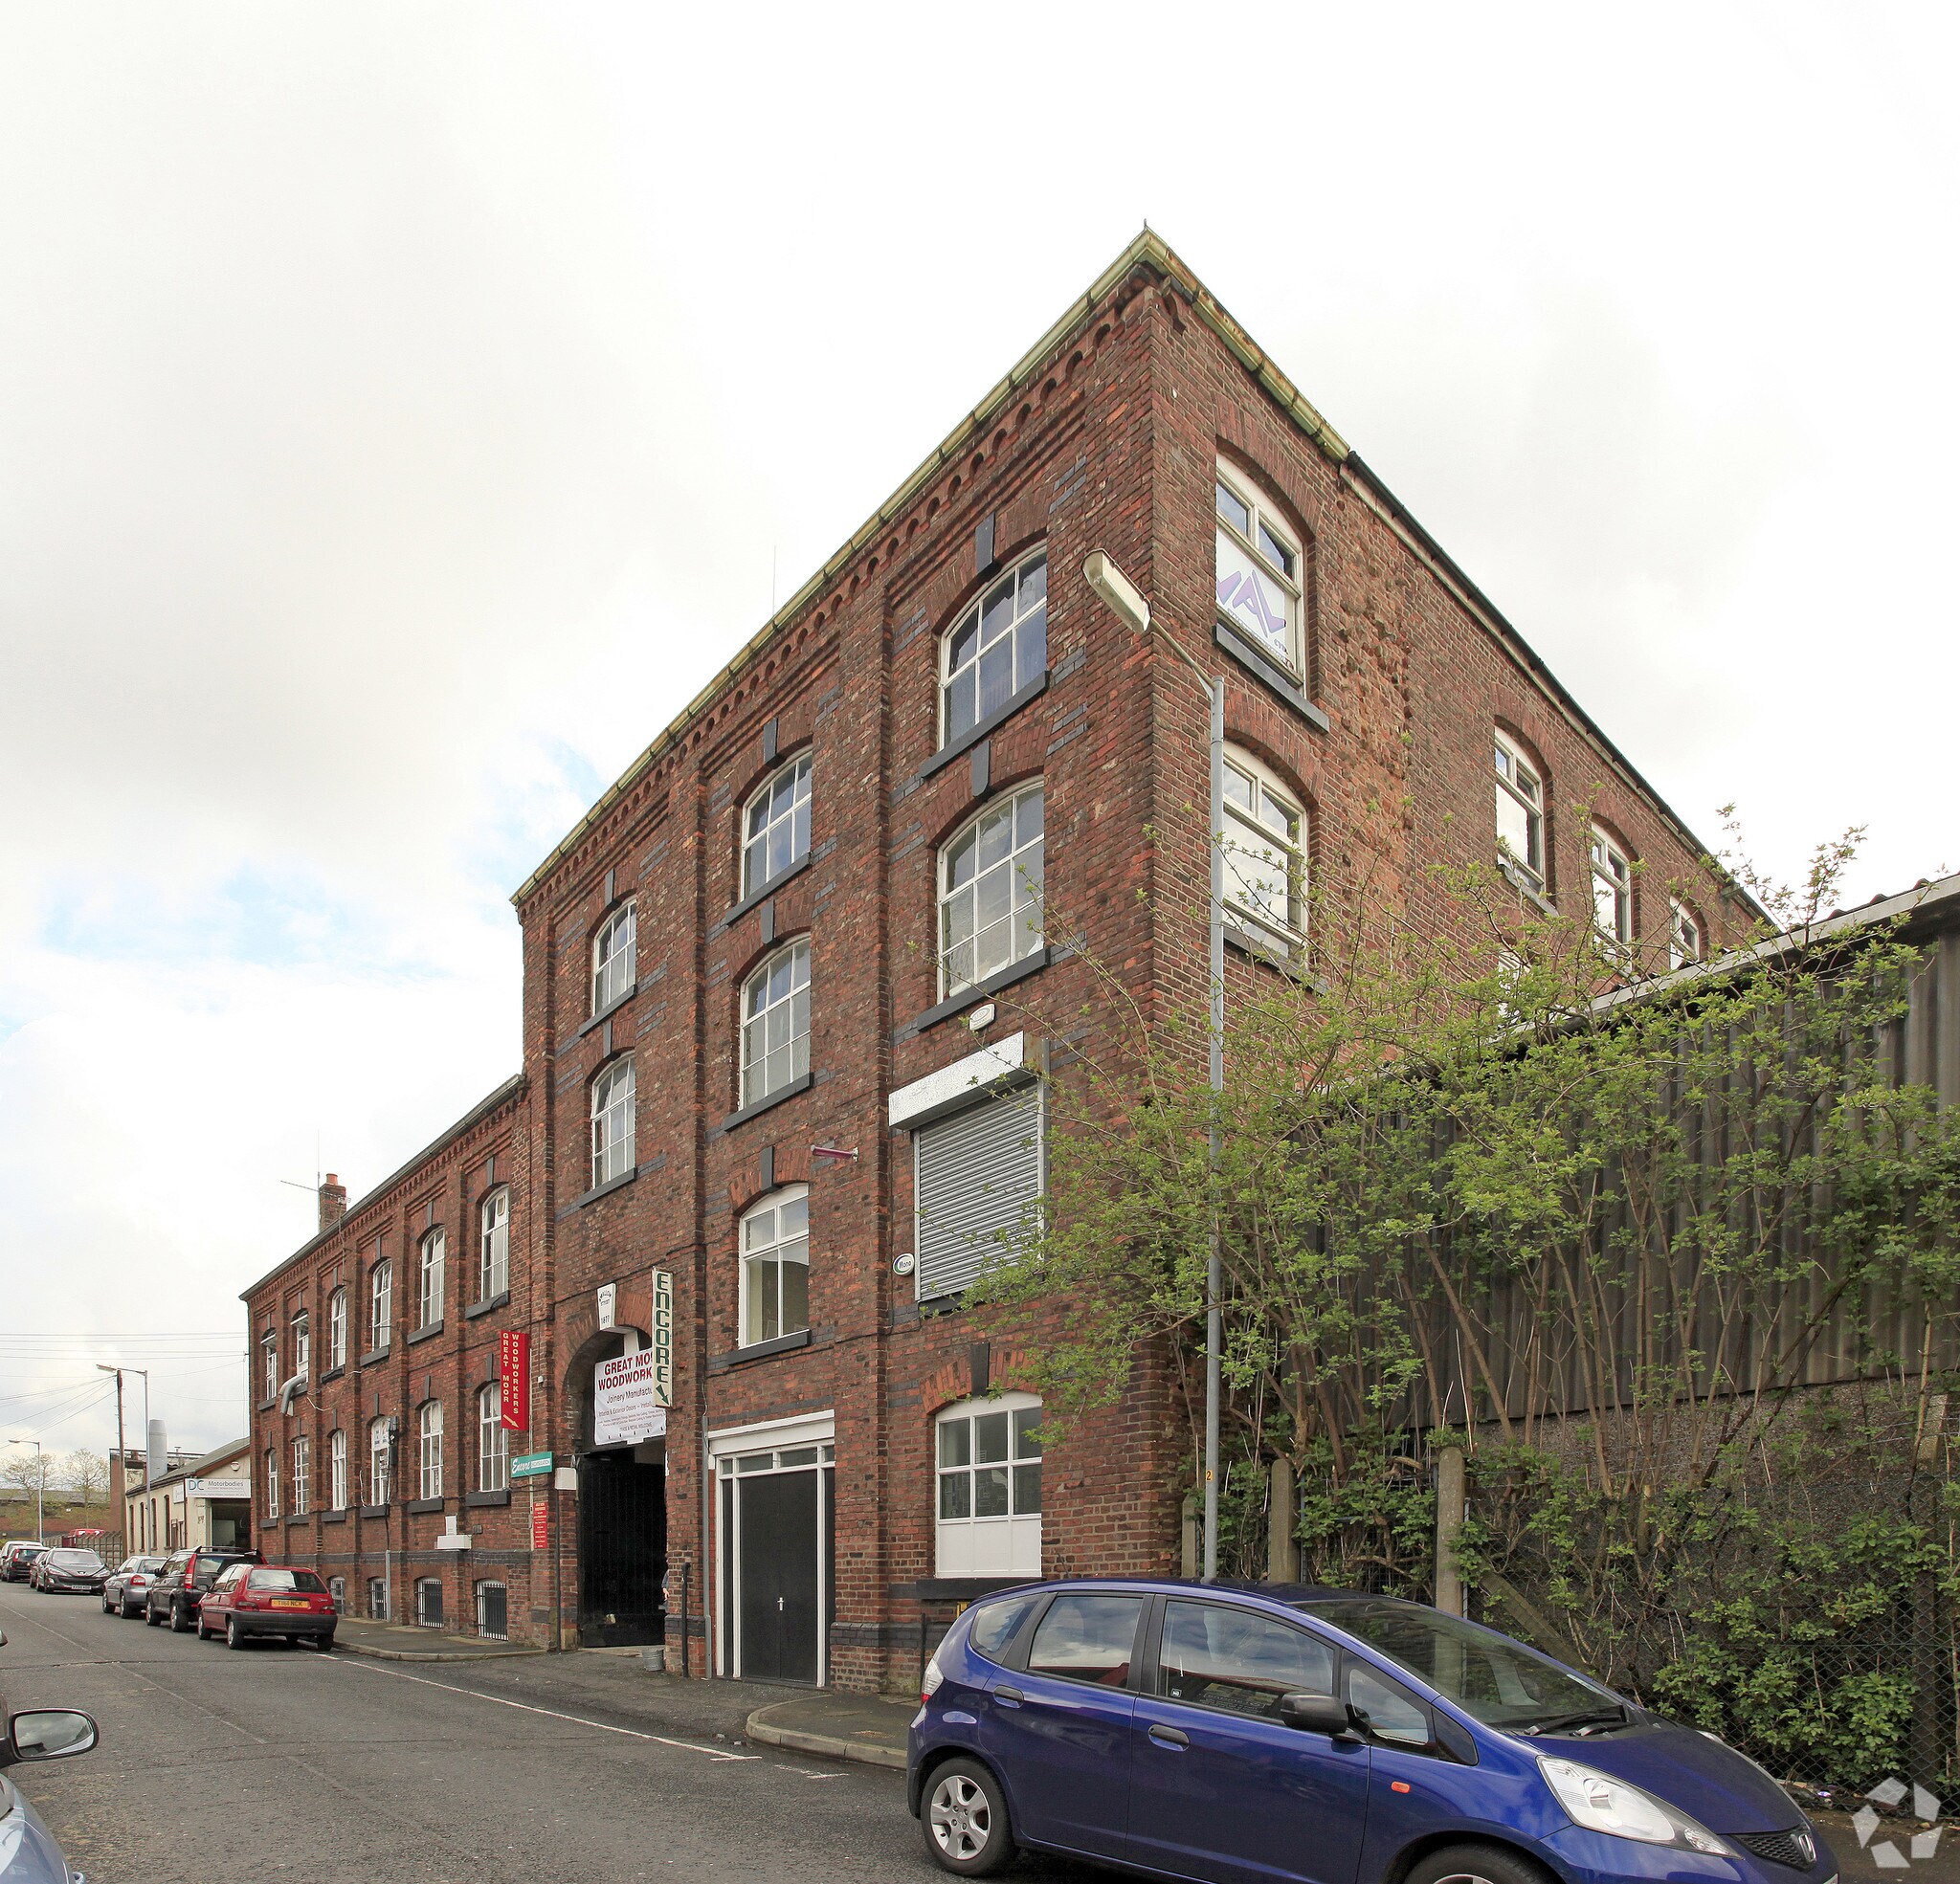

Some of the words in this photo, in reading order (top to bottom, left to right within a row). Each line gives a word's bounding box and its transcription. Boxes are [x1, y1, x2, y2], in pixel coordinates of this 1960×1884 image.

[656, 1273, 670, 1384] ENCORE
[605, 1357, 633, 1376] GREAT
[635, 1352, 653, 1367] MO
[598, 1366, 653, 1390] WOODWORK
[607, 1392, 625, 1404] Joinery
[625, 1386, 653, 1400] Manufactu
[512, 1458, 531, 1474] Encore
[189, 1480, 204, 1490] DC
